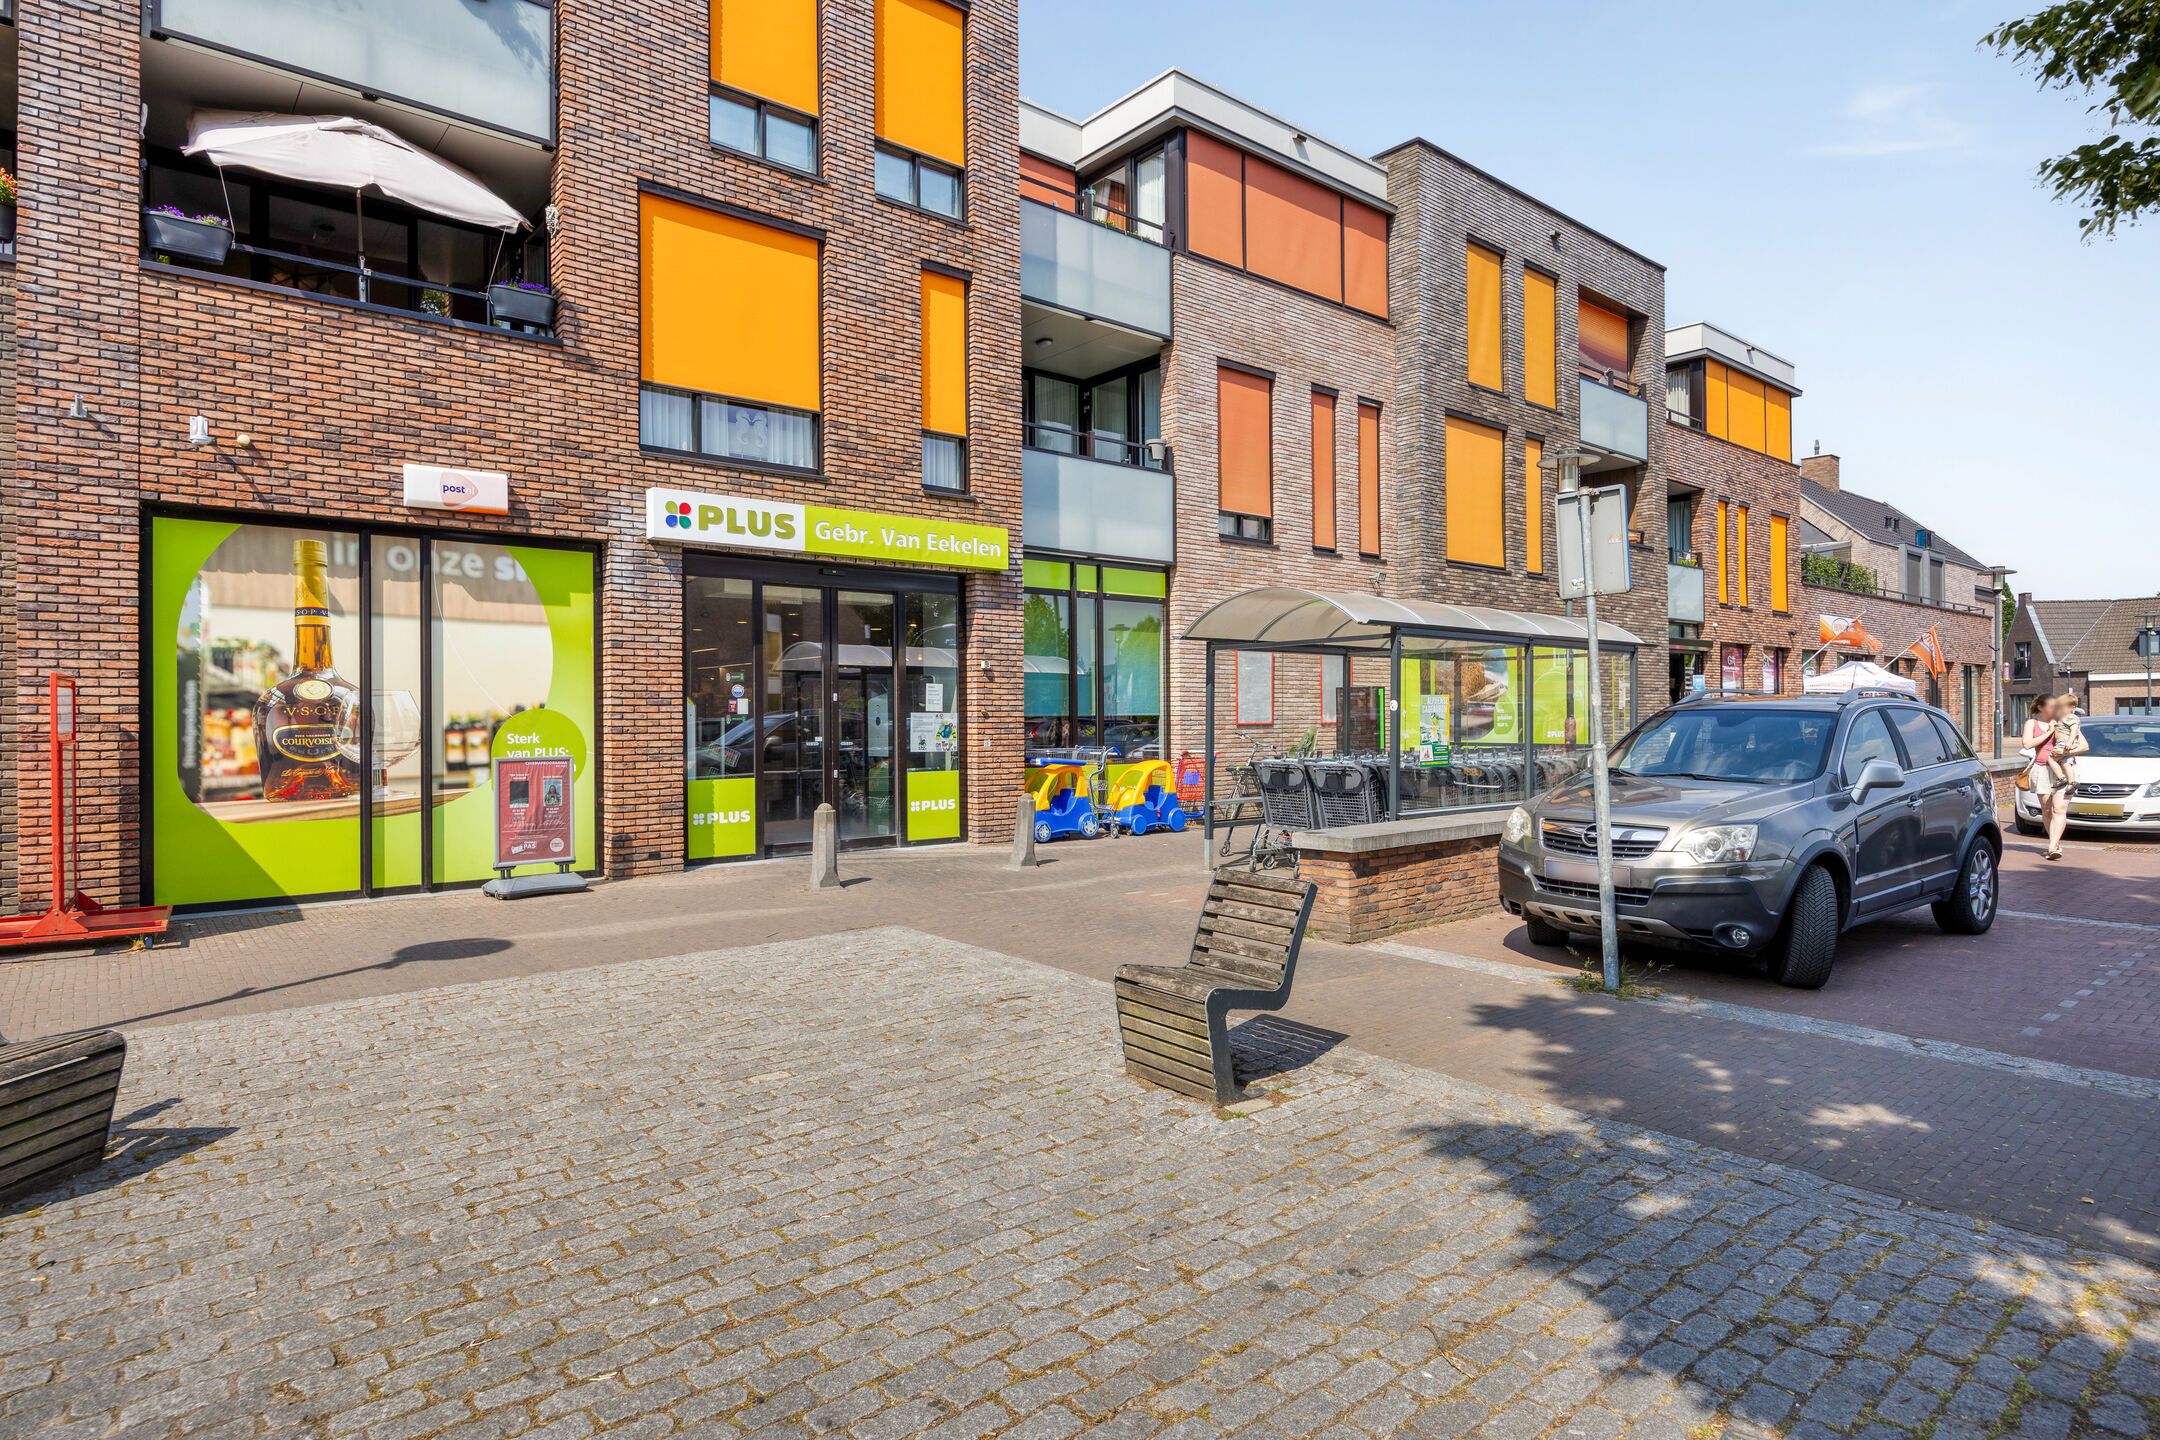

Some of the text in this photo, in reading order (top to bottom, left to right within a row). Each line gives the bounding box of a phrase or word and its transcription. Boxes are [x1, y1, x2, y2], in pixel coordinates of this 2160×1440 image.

[698, 504, 796, 540] PLUS
[815, 521, 1001, 558] Gebr. Van Eekelen
[506, 732, 540, 744] Sterk
[506, 750, 531, 758] van
[922, 798, 956, 812] PLUS
[706, 810, 751, 825] PLUS
